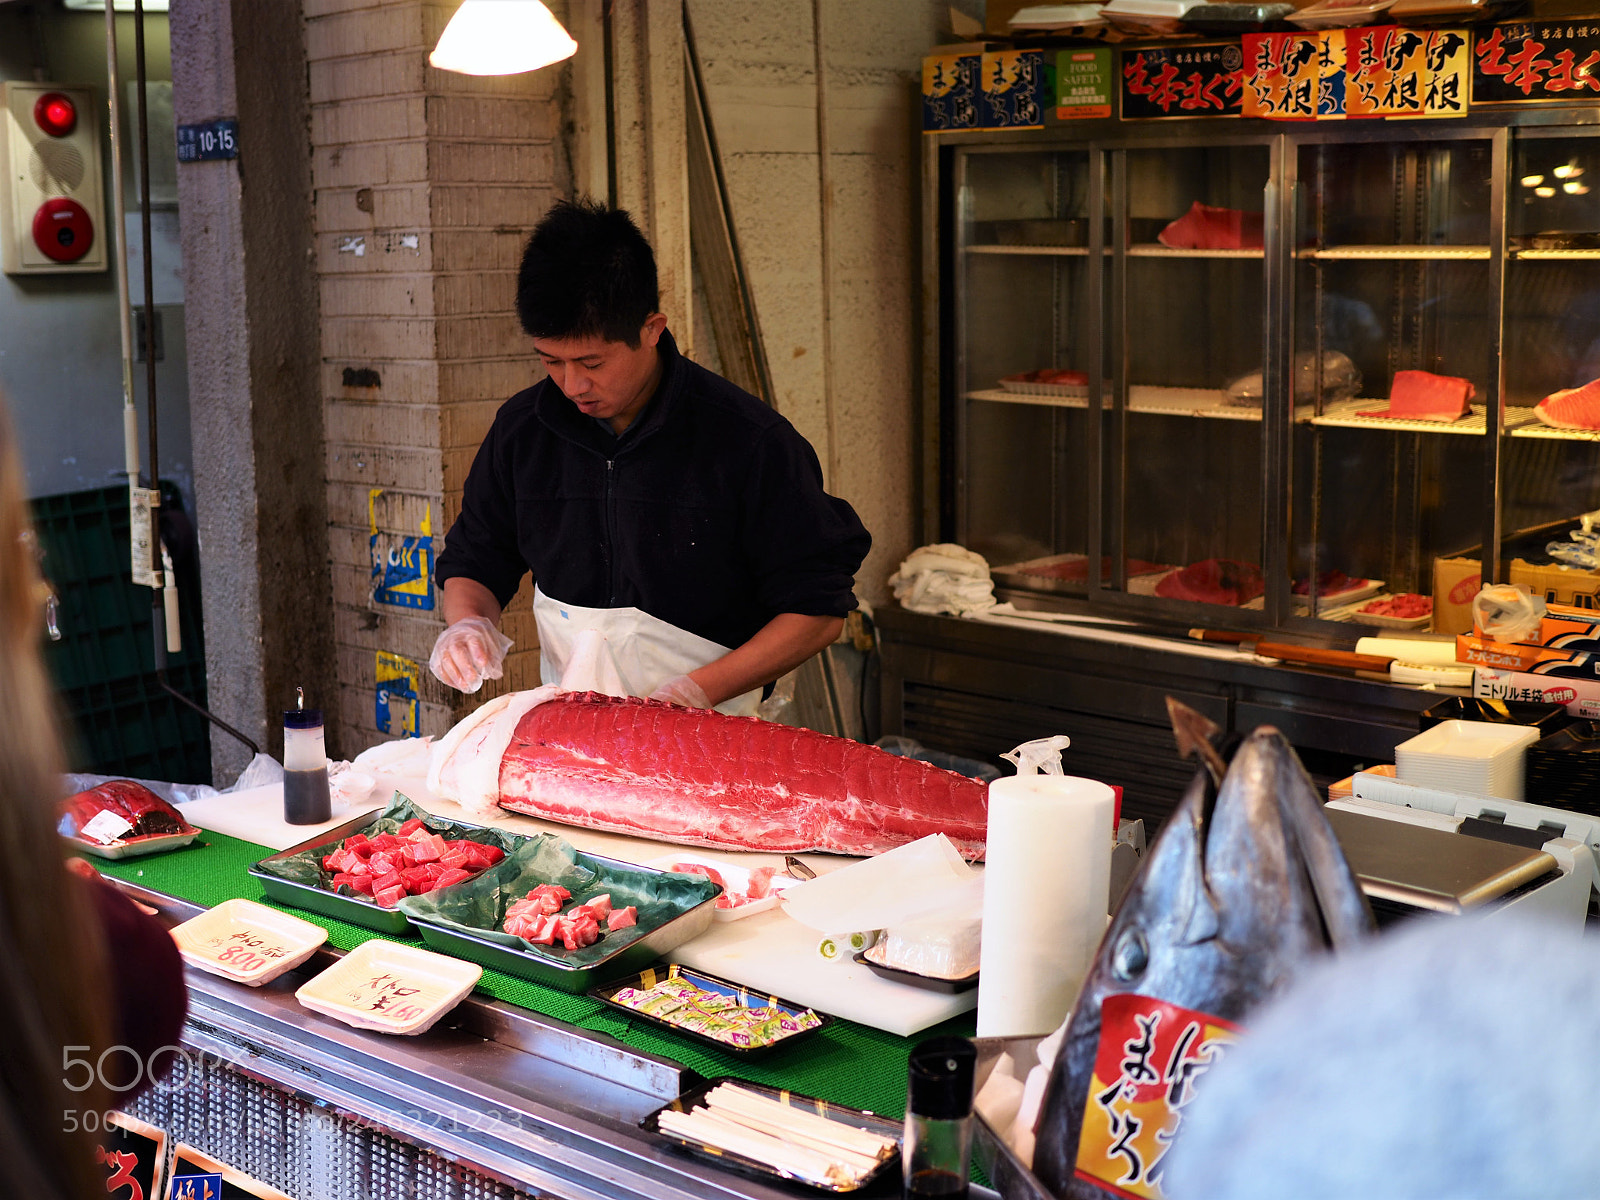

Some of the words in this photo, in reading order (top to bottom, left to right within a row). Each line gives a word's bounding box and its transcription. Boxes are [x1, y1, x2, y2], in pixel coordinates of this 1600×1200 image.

[1063, 74, 1101, 84] SAFETY
[1070, 63, 1097, 73] FOOD
[1248, 38, 1277, 117] まぐろ
[1279, 37, 1317, 115] 伊根
[1351, 32, 1379, 113] まぐろ
[1383, 31, 1423, 110] 伊根
[1425, 31, 1465, 111] 伊根
[199, 129, 234, 152] 10-15
[1466, 649, 1522, 667] スーパーエンボス
[1480, 683, 1543, 702] ニトリル手袋
[217, 945, 266, 972] 800
[1095, 1010, 1163, 1186] まぐろ
